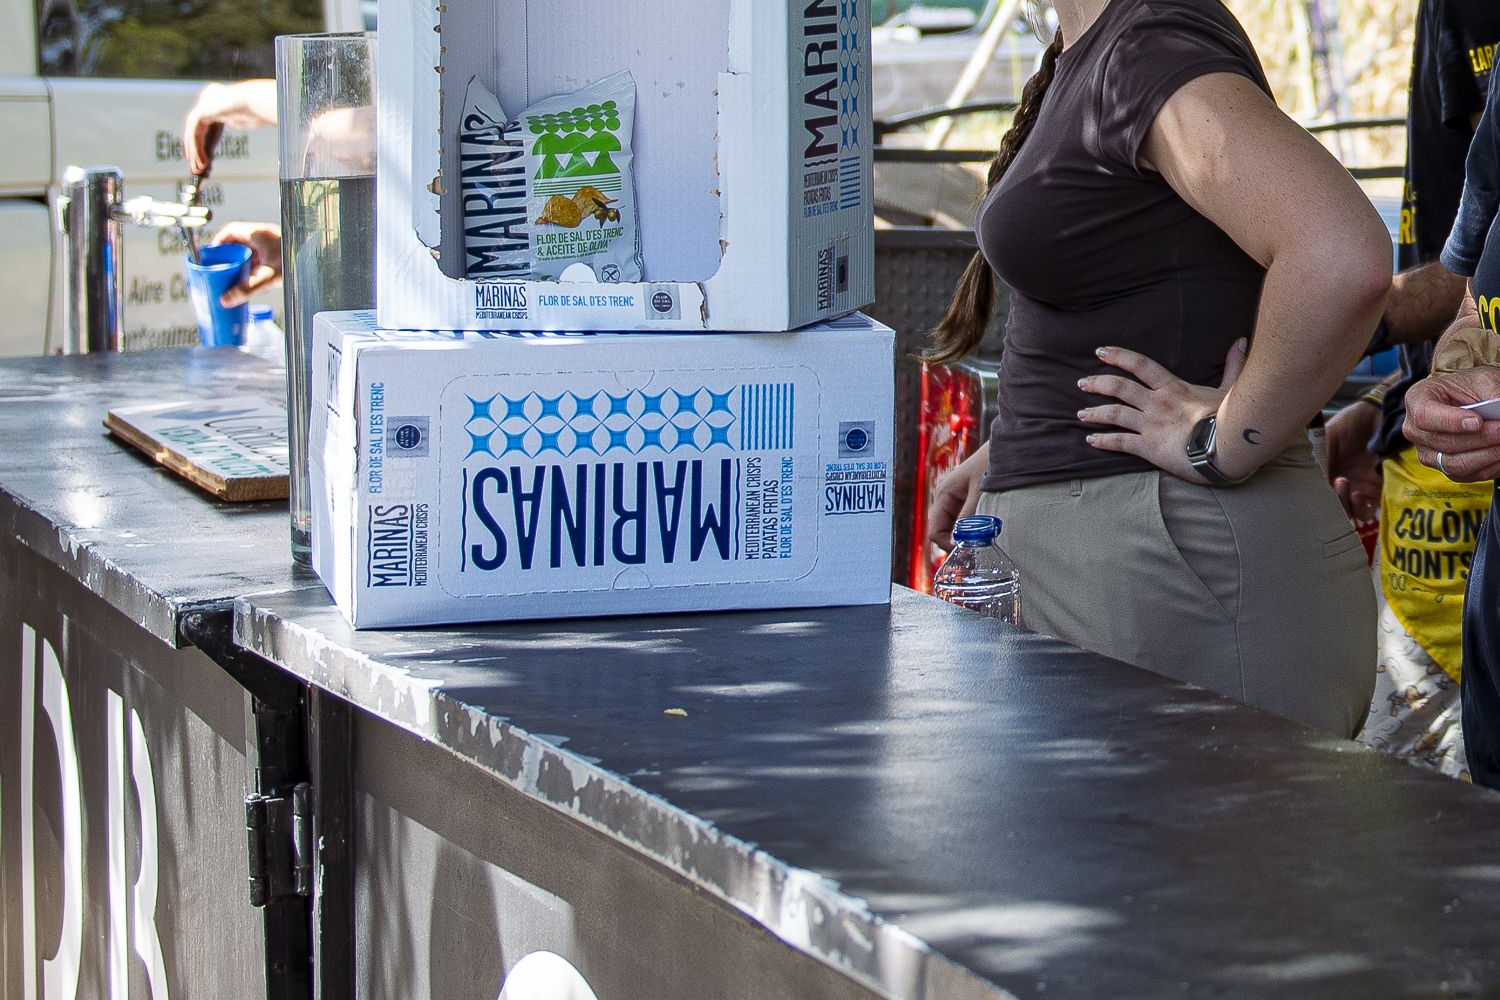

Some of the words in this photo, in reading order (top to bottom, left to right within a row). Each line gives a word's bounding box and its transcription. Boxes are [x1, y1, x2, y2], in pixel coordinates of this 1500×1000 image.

[536, 233, 557, 245] FLOR
[558, 232, 569, 243] DE
[570, 231, 585, 242] SAL
[586, 229, 602, 241] D'ES
[603, 226, 624, 238] TRENC
[537, 246, 544, 257] &
[546, 243, 576, 256] ACEITE
[577, 242, 588, 253] DE
[817, 248, 829, 312] MARINAS
[475, 285, 527, 307] MARINAS
[538, 295, 559, 306] FLOR
[560, 296, 571, 306] DE
[572, 295, 588, 306] SAL
[589, 296, 607, 307] D'ES
[608, 296, 635, 307] TRENC
[475, 311, 512, 319] MEDITERRANEAN
[512, 311, 528, 319] CRISPS
[371, 382, 385, 410] TRENC
[371, 410, 384, 433] D'ES
[370, 434, 384, 455] SAL
[369, 455, 383, 471] DE
[746, 457, 761, 488] CRISPS
[782, 456, 794, 483] TRENC
[369, 472, 383, 494] FLOR
[825, 472, 844, 482] CRISPS
[844, 470, 887, 480] MEDITERRANEAN
[763, 480, 779, 514] FRITAS
[781, 485, 793, 504] D'ES
[825, 484, 886, 512] MARINAS
[415, 503, 429, 529] CRISPS
[471, 458, 732, 571] MARINAS
[745, 490, 761, 560] MEDITERRANEAN
[781, 506, 793, 523] SAL
[1394, 501, 1488, 543] COLÒN
[762, 517, 778, 560] PATATAS
[781, 524, 793, 538] DE
[373, 504, 409, 588] MARINAS
[780, 538, 792, 559] FLOR
[415, 529, 429, 587] MEDITERRANEAN
[1392, 545, 1472, 581] MONTS
